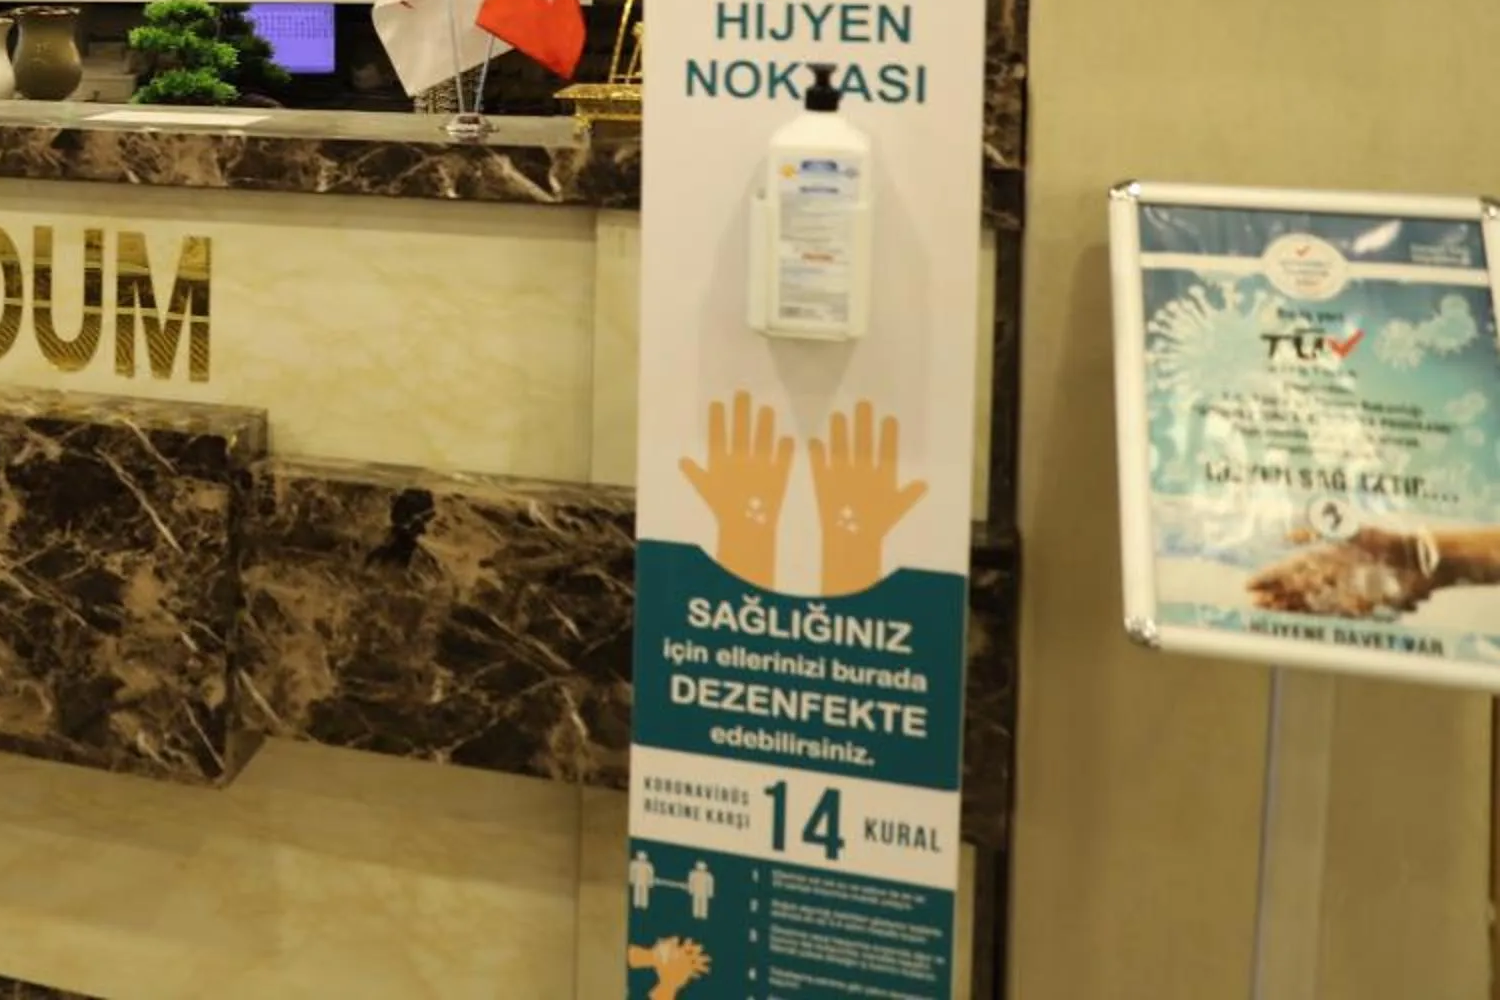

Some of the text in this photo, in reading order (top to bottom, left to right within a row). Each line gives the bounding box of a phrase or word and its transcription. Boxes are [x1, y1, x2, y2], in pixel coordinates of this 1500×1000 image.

[685, 60, 927, 104] NOKASI
[686, 594, 914, 654] SAĞLIĞINIZ
[715, 641, 827, 679] ellerinizi
[831, 656, 928, 693] burada
[670, 674, 928, 738] DEZENFEKTE
[709, 723, 876, 767] edebilirsiniz.
[764, 780, 943, 861] 14 KURAL
